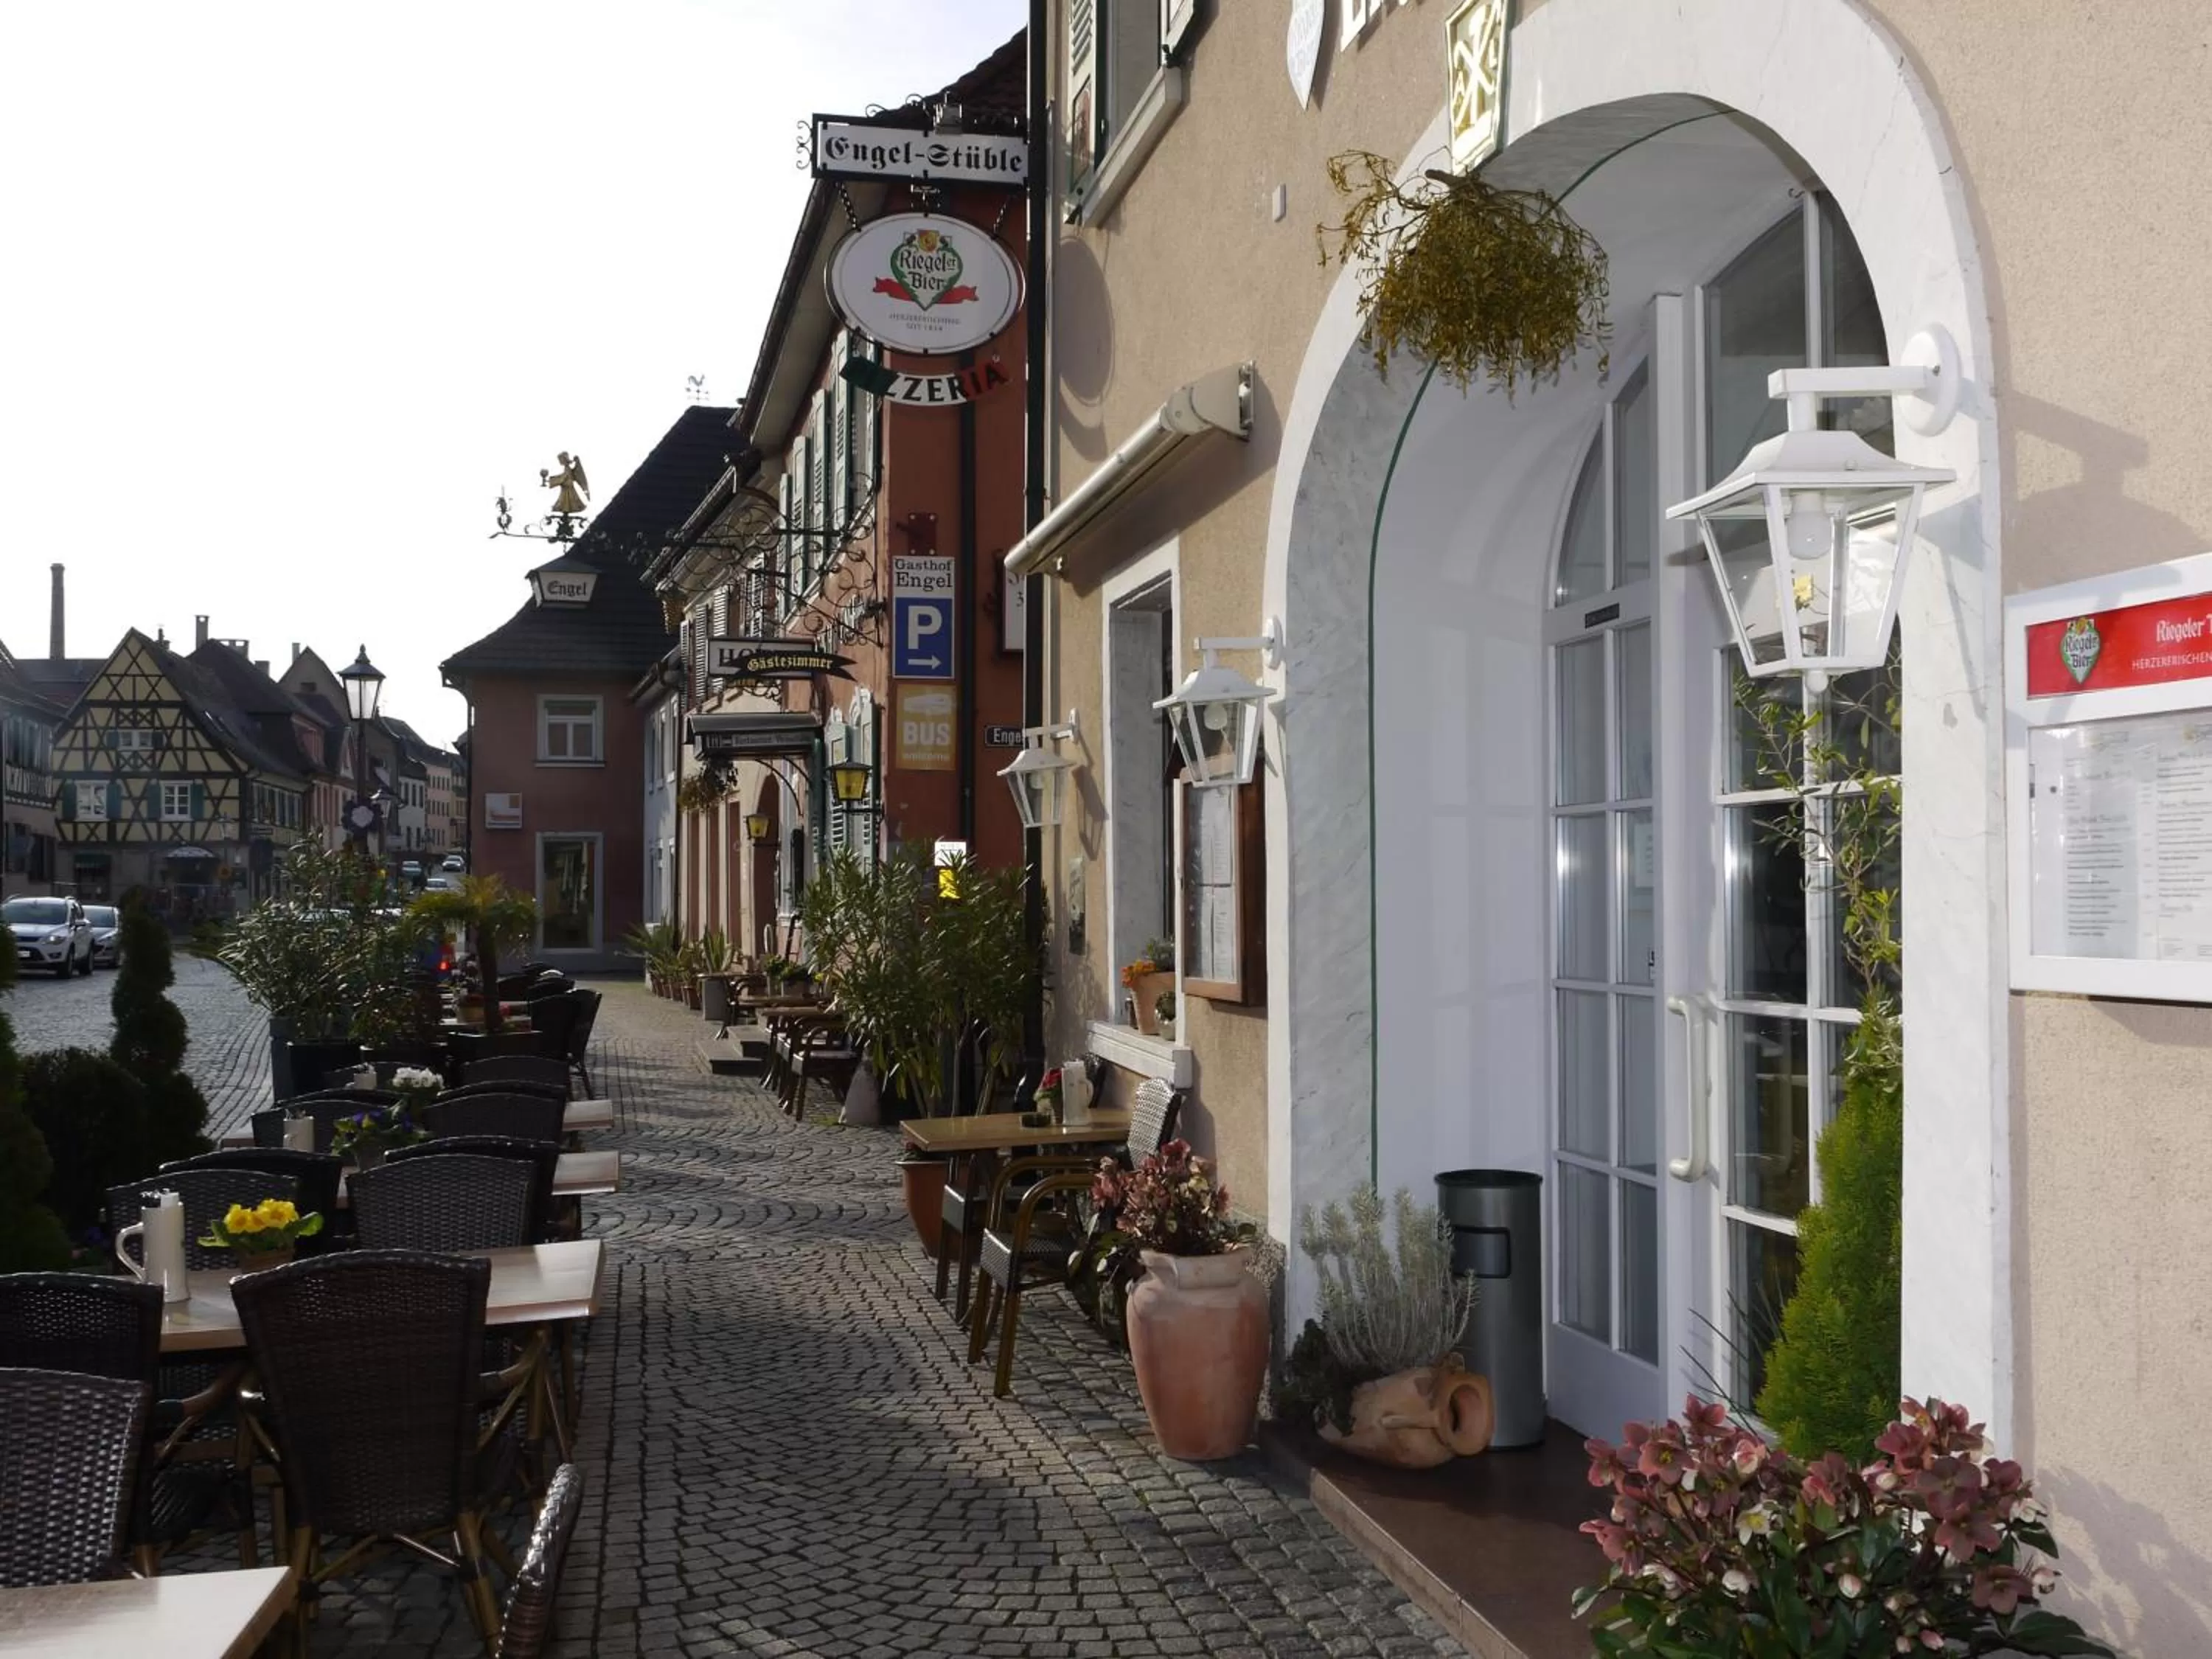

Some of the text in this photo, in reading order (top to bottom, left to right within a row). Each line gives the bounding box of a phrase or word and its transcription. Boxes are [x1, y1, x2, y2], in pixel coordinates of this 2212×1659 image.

[824, 136, 1023, 172] Engel-Stüble
[900, 249, 956, 273] Riegeler
[908, 271, 945, 290] Bier
[895, 558, 951, 571] Gasthof
[546, 580, 587, 597] Engel
[895, 571, 953, 592] Engel
[908, 605, 943, 650] P
[746, 654, 834, 672] Gästezimmer
[903, 721, 951, 746] BUS
